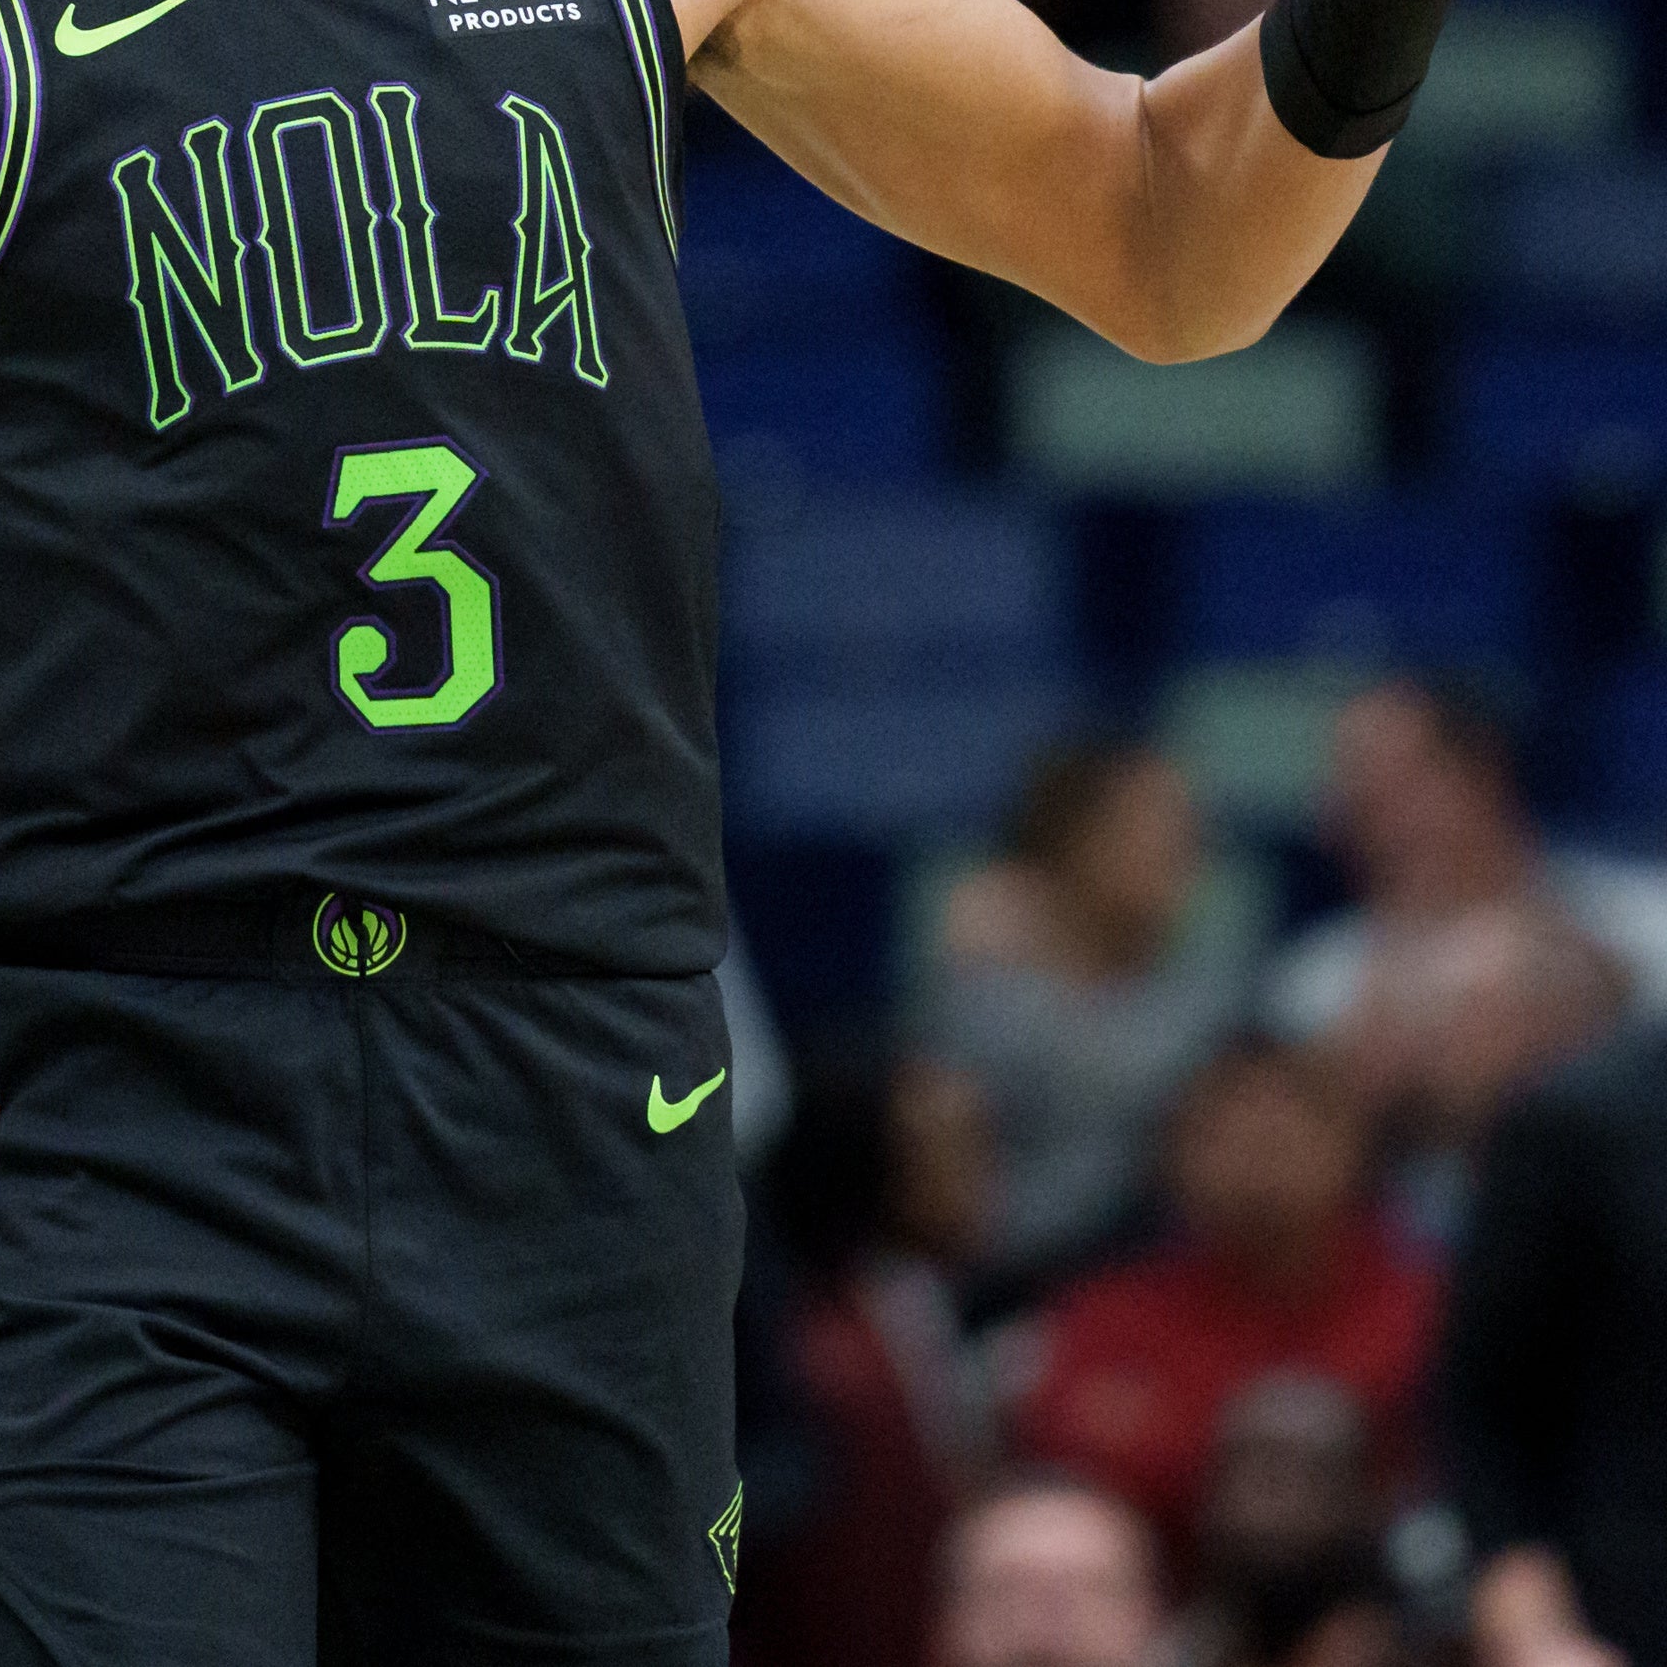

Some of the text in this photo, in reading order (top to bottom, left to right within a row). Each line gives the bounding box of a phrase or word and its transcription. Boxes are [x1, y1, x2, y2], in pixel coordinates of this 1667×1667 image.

[448, 2, 582, 32] PRODUCTS
[111, 84, 609, 430] NOLA
[324, 435, 506, 734] 3
